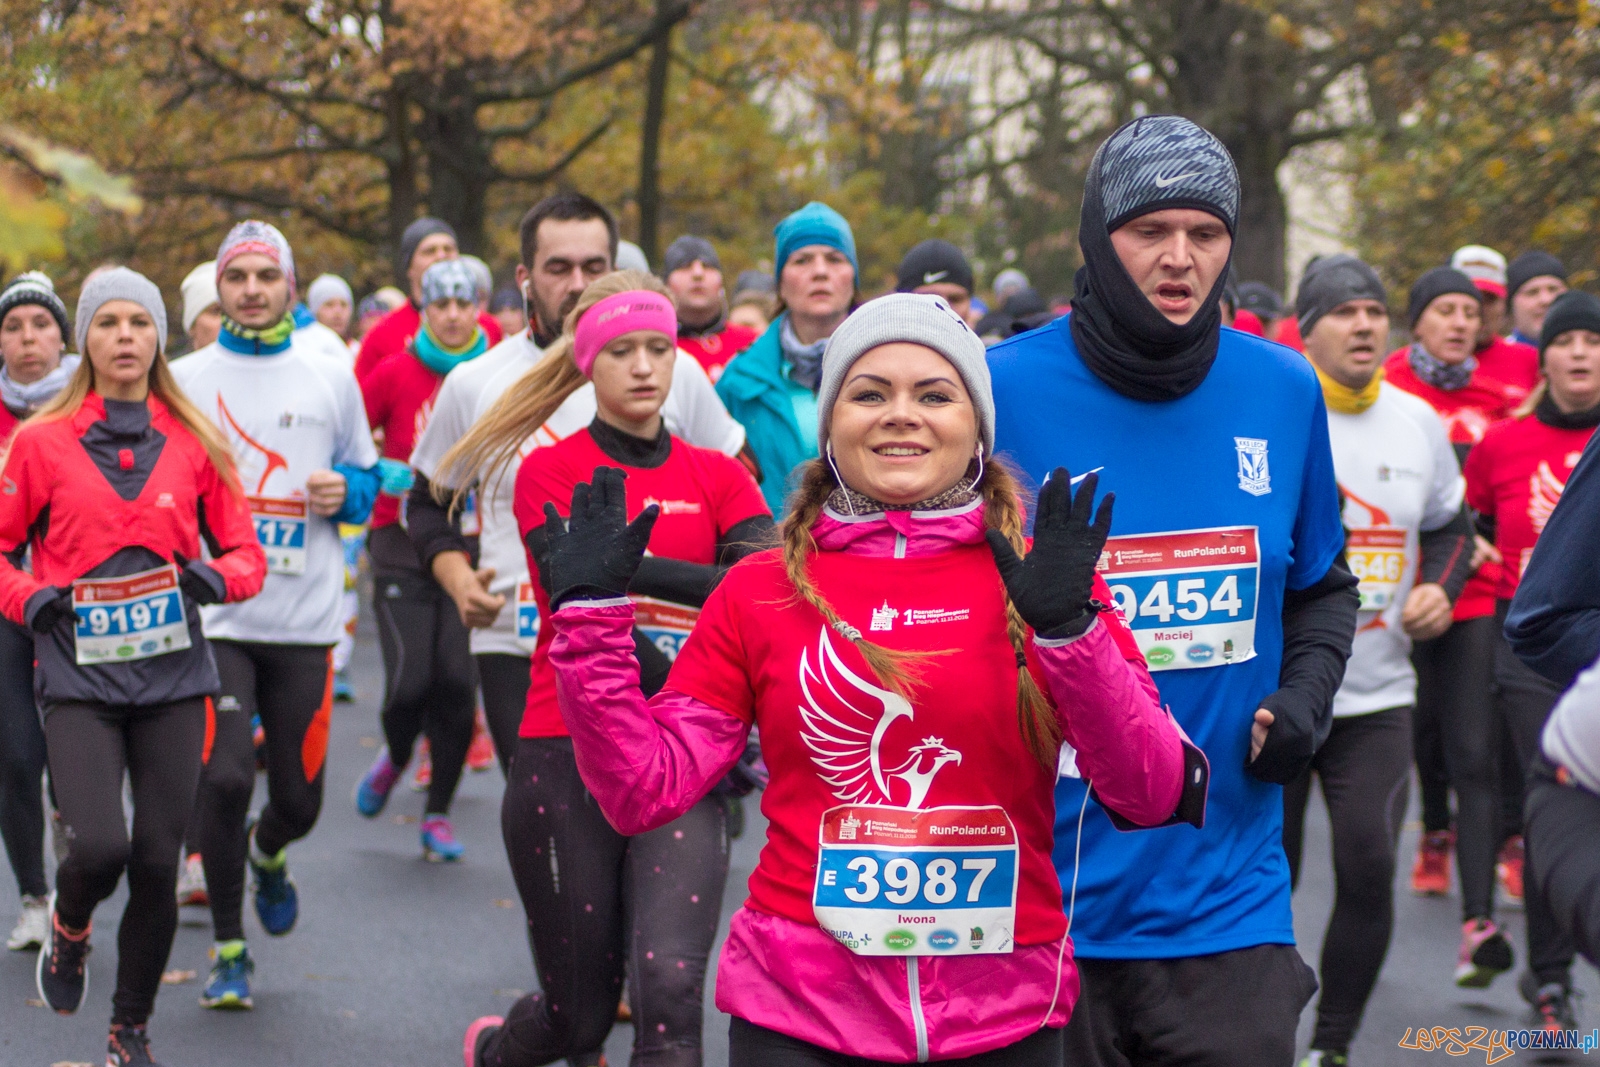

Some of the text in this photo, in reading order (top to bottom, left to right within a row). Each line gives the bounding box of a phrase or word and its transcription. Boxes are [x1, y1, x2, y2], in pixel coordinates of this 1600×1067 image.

[1114, 550, 1124, 565] 1
[1173, 545, 1246, 558] RunPoland.org
[1109, 574, 1243, 625] 9454
[88, 596, 170, 636] 9197
[903, 608, 914, 625] 1
[1154, 630, 1194, 641] Maciej
[864, 819, 873, 836] 1
[929, 824, 1006, 836] RunPoland.org
[823, 870, 838, 886] E
[844, 856, 998, 905] 3987
[897, 914, 937, 924] Iwona
